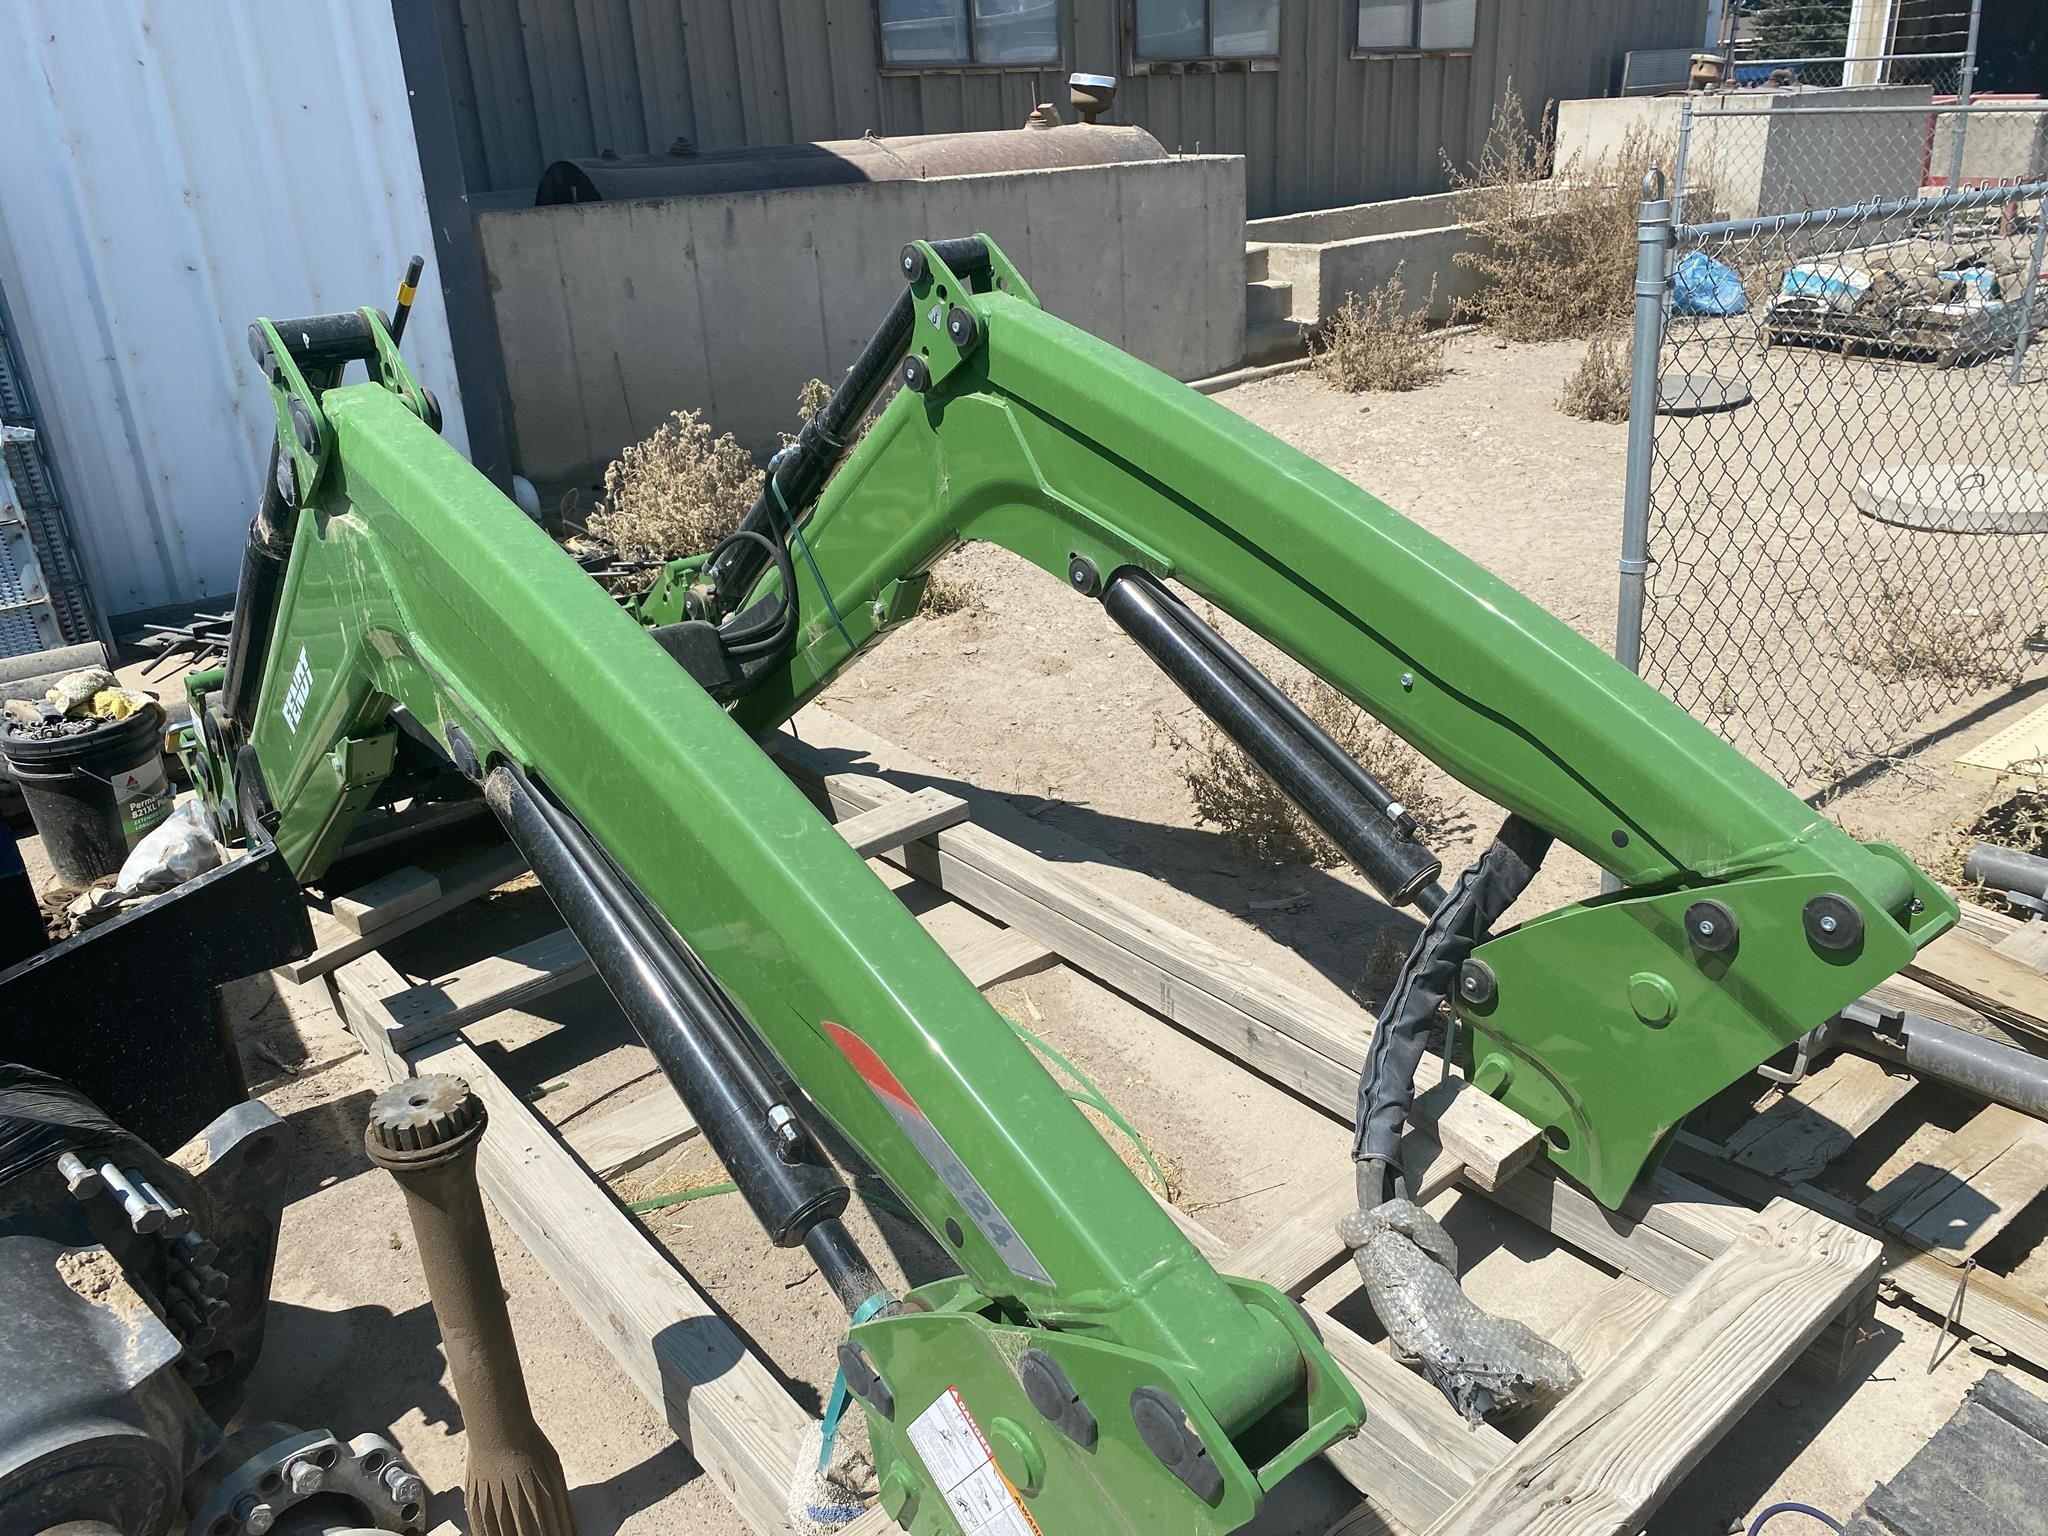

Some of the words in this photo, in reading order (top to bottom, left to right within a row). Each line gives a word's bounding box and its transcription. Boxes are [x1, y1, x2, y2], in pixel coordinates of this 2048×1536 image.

[282, 645, 313, 735] FENDT
[131, 803, 156, 819] 821XL
[958, 1400, 992, 1454] DANGER
[1021, 1505, 1042, 1536] WAR
